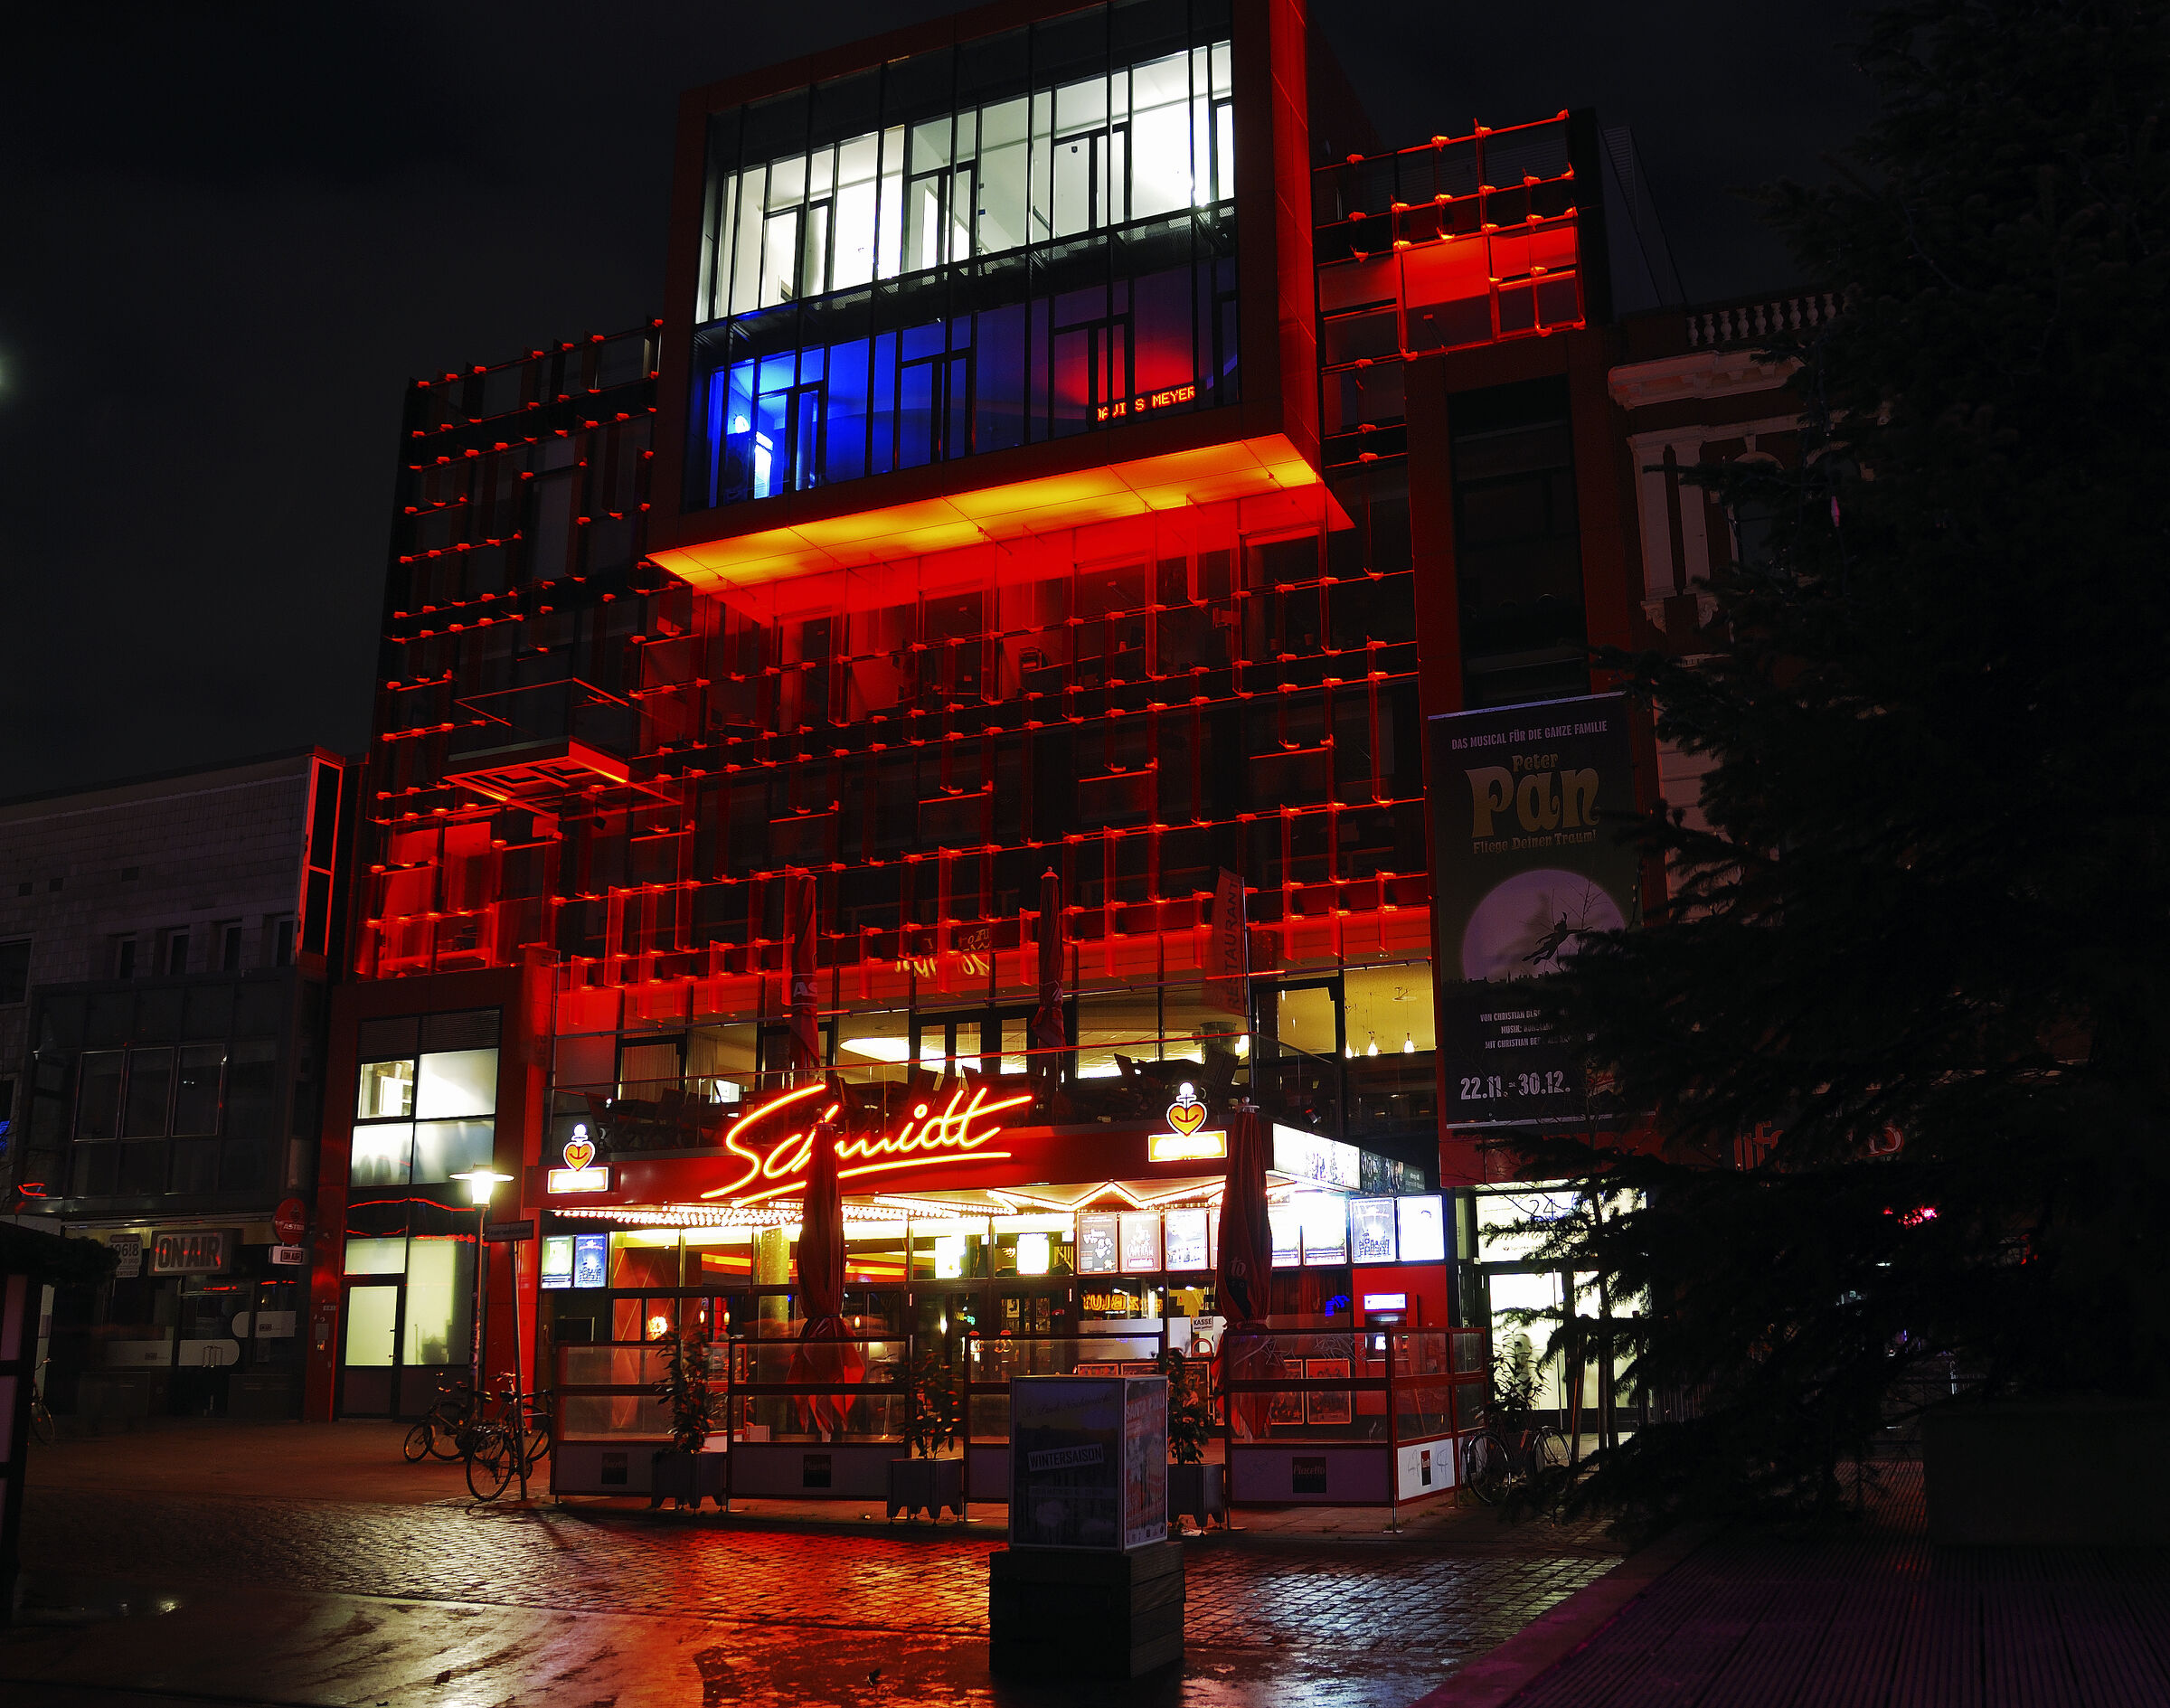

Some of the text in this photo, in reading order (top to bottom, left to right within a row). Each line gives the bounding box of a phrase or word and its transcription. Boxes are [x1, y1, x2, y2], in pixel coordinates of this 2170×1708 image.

[1451, 721, 1607, 750] DAS MUSICAL FÜR DIE GANZE FAMILIE
[1511, 752, 1559, 773] Peter
[1463, 766, 1599, 838] Pan
[1473, 829, 1598, 854] Fliege Deinen Traum!
[1479, 1014, 1492, 1023] VON
[1494, 1010, 1524, 1021] CHRISTIAN
[1485, 1040, 1495, 1049] MIT
[1497, 1038, 1528, 1048] CHRISTIAN
[158, 1236, 221, 1269] ON AIR
[1029, 1446, 1102, 1469] WINTERSAISON
